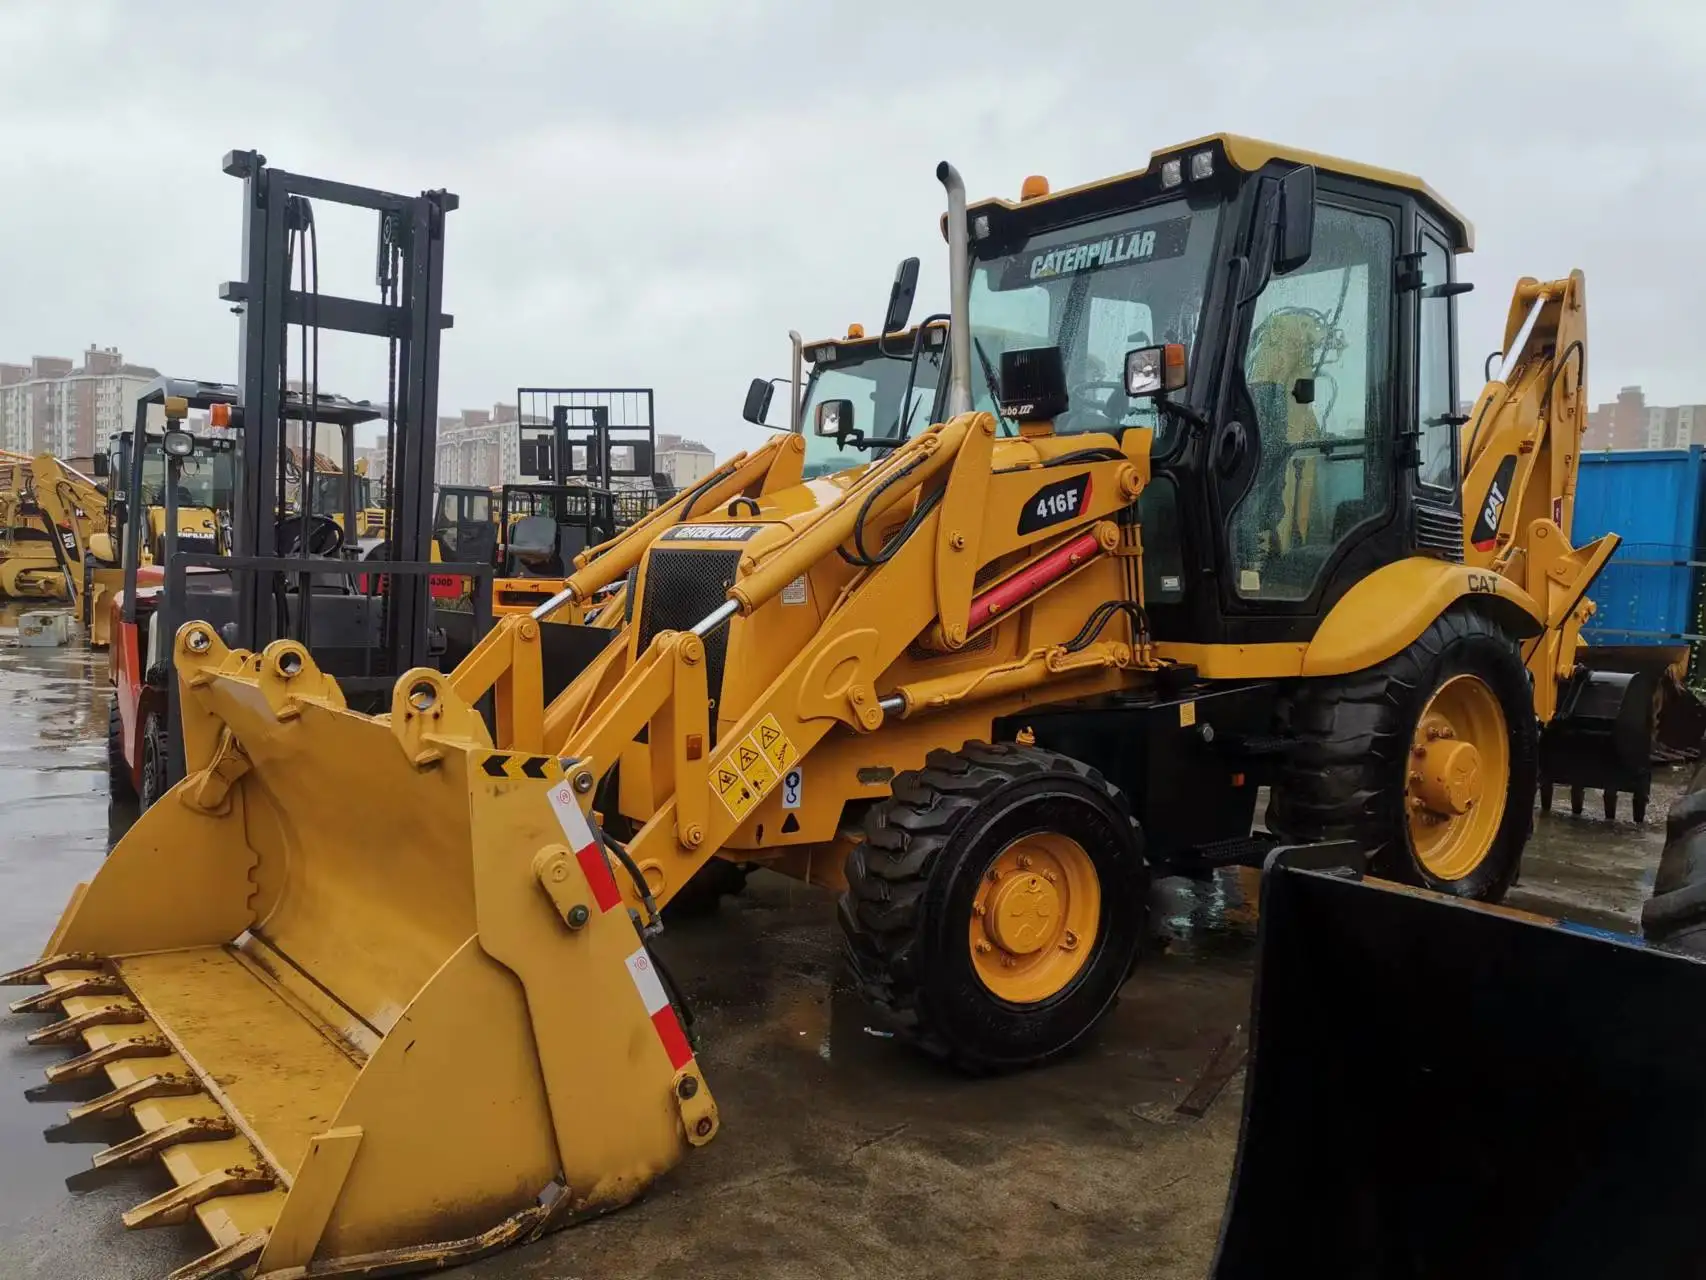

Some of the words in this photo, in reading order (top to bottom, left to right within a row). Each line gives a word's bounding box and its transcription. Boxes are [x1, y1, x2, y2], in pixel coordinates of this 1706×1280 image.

[1030, 230, 1157, 279] CATERPILLAR
[1036, 488, 1078, 518] 416F
[1484, 481, 1505, 531] CAT
[62, 532, 76, 549] CAT
[1468, 574, 1498, 593] CAT
